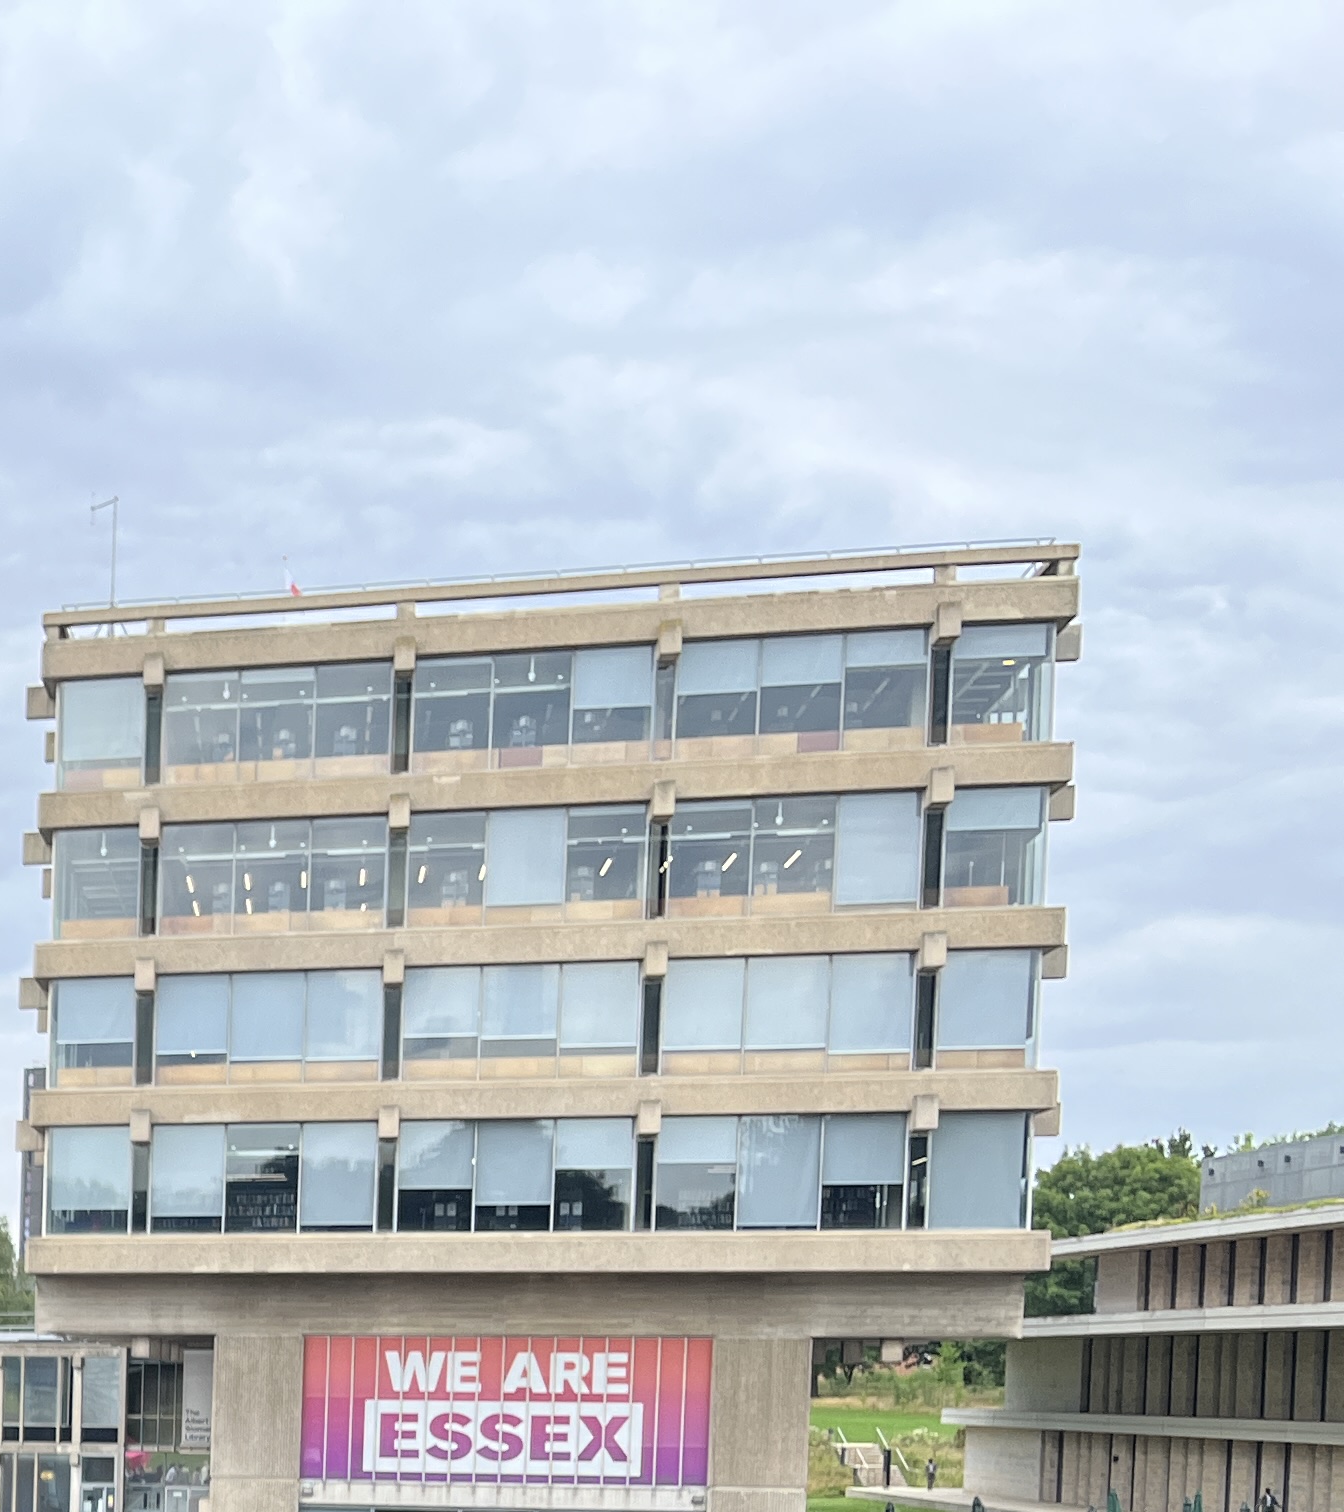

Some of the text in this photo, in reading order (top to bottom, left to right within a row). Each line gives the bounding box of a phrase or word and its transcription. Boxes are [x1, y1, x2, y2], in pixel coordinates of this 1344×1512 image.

[385, 1351, 629, 1394] WE ARE
[379, 1413, 629, 1461] ESSEX
